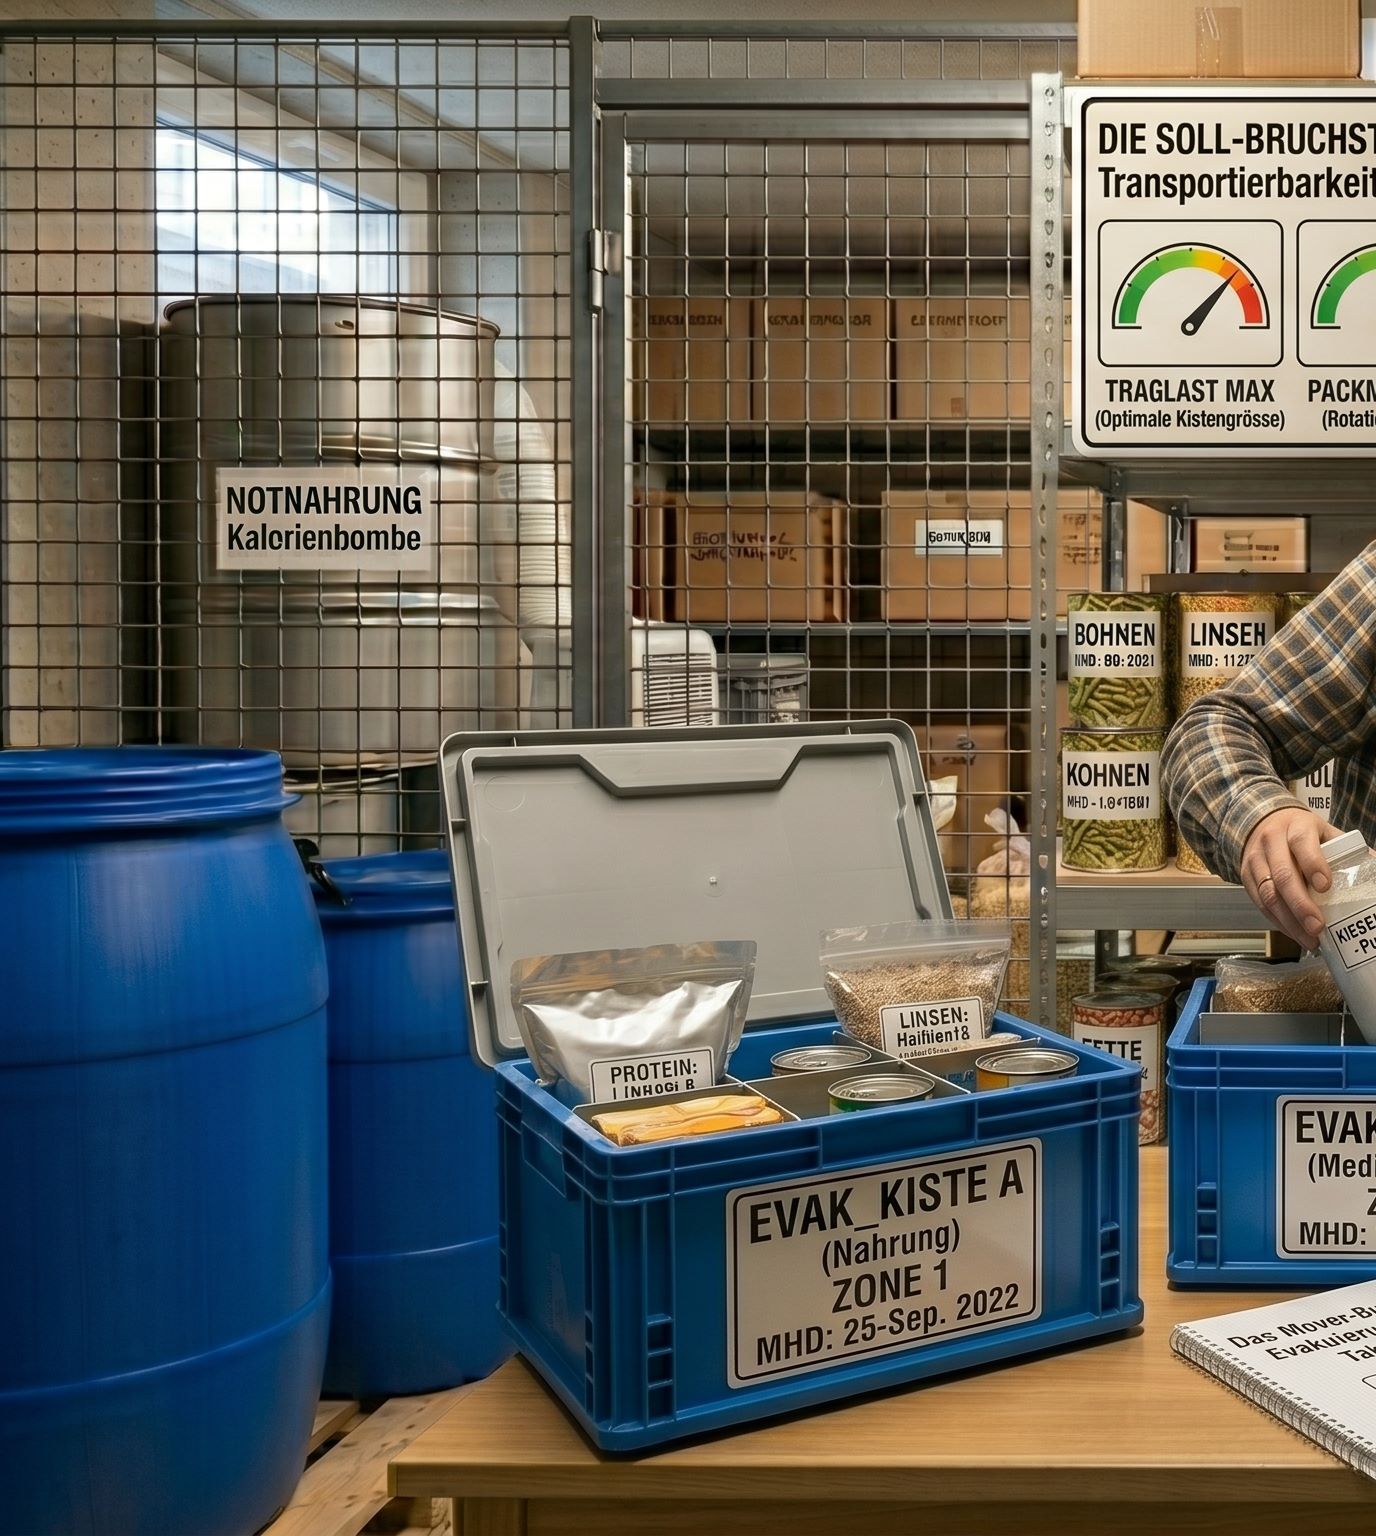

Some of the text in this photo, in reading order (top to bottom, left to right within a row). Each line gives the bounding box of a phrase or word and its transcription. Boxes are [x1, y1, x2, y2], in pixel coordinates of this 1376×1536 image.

[1098, 122, 1147, 155] DIE
[1105, 379, 1275, 403] TRAGLAST MAX
[1094, 409, 1286, 431] (Optimale Kistengrösse)
[226, 486, 423, 515] NOTNAHRUNG
[227, 523, 422, 552] Kalorienbombe
[1075, 622, 1156, 647] BOHNEN
[1127, 653, 1155, 667] 2021
[1066, 762, 1150, 787] KOHNEN
[899, 1006, 969, 1029] LINSEN:
[610, 1058, 698, 1084] PROTEIN:
[750, 1158, 1024, 1244] EVAK_KISTE A
[1299, 1222, 1367, 1247] MHD:
[822, 1218, 961, 1277] (Nahrung)
[832, 1258, 948, 1314] ZONE 1
[757, 1282, 1020, 1366] MHD: 25-Sep. 2022
[1227, 1327, 1278, 1350] Das
